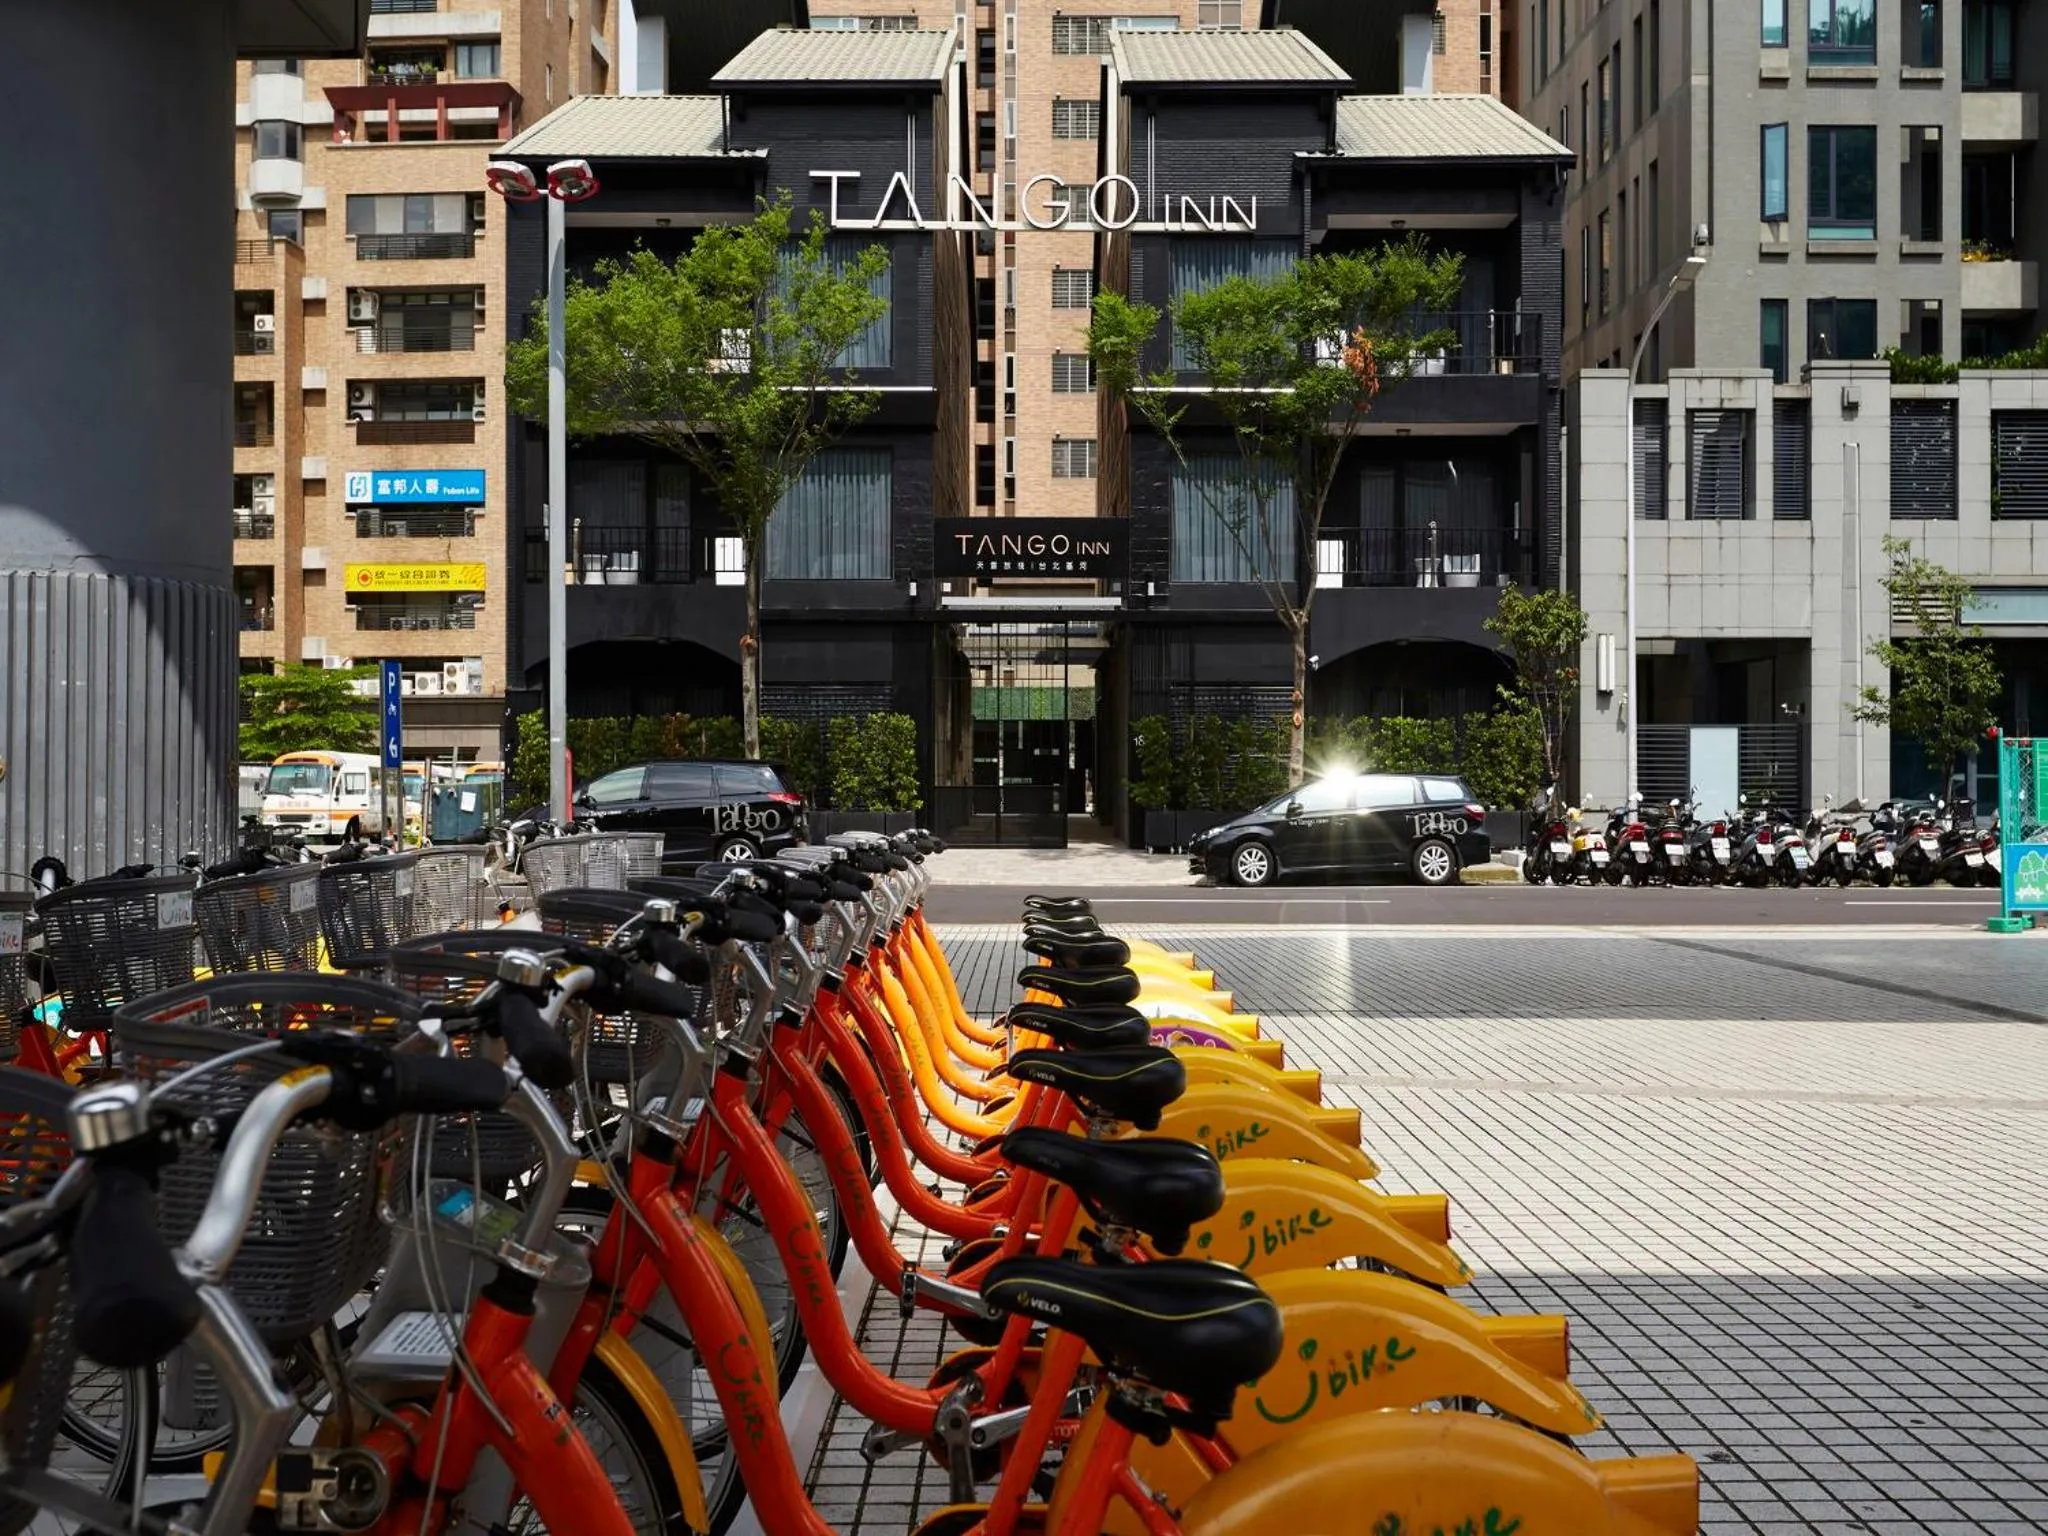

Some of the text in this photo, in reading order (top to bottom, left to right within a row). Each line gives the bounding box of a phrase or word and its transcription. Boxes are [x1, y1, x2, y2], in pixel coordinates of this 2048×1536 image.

[809, 169, 1257, 232] TANGO INN
[377, 478, 440, 495] 富邦人壽
[953, 533, 1110, 556] TANGO INN
[387, 671, 397, 695] P
[702, 800, 781, 844] Tango
[1405, 809, 1469, 844] Tango
[1031, 1296, 1061, 1314] VELO
